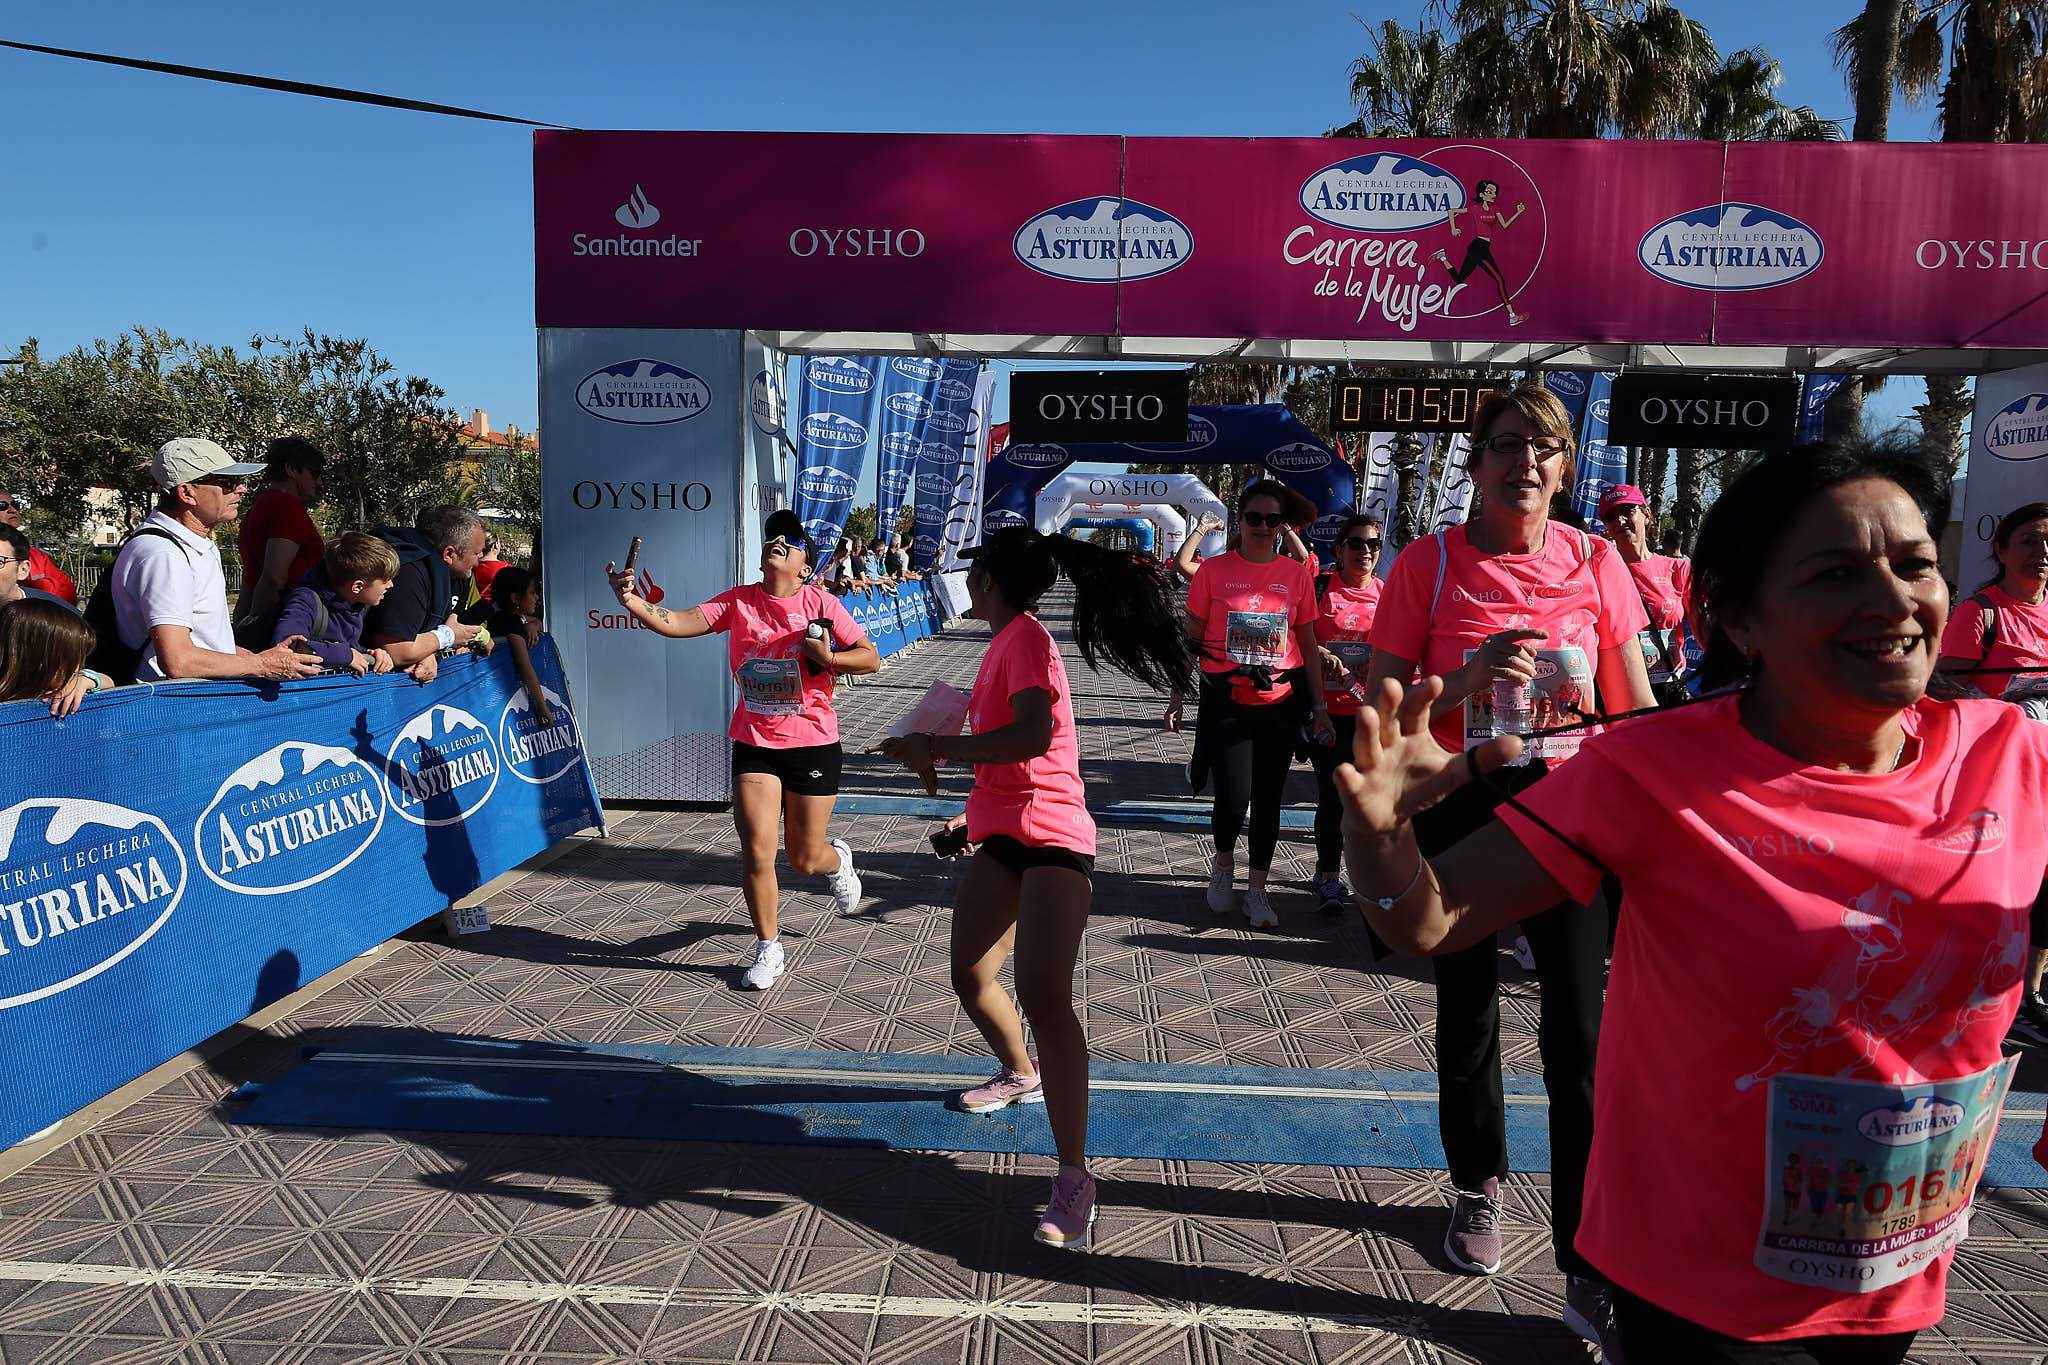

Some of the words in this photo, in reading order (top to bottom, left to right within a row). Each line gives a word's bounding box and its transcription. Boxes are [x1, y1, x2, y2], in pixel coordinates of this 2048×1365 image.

[1311, 180, 1452, 212] ASTURIANA
[1338, 179, 1391, 188] CENTRAL
[1395, 180, 1449, 189] LECHERA
[788, 228, 926, 258] OYSHO
[1055, 226, 1111, 235] CENTRAL
[1681, 233, 1739, 242] CENTRAL
[1744, 233, 1805, 242] LECHERA
[573, 233, 703, 257] Santander
[1027, 228, 1180, 260] ASTURIANA
[1282, 225, 1418, 270] Carrera
[1651, 234, 1809, 268] ASTURIANA
[1314, 268, 1339, 297] de
[1344, 268, 1363, 298] la
[1356, 264, 1468, 332] Mujer
[606, 381, 650, 389] CENTRAL
[653, 381, 697, 390] LECHERA
[808, 364, 869, 389] ASTURIANA
[586, 383, 702, 409] ASTURIANA
[1038, 394, 1164, 421] OYSHO
[1639, 397, 1770, 427] OYSHO
[804, 420, 862, 443] ASTURIANA
[1009, 450, 1063, 462] ASTURIANA
[1271, 454, 1328, 466] ASTURIANA
[572, 480, 712, 512] OYSHO
[798, 481, 853, 496] ASTURIANA
[1088, 479, 1169, 497] OYSHO
[1308, 525, 1341, 537] ASTUR
[1472, 729, 1492, 738] CARR
[1544, 743, 1580, 751] Santande
[400, 747, 495, 809] ASTURIANA
[240, 786, 304, 817] CENTRAL
[306, 770, 364, 796] LECHERA
[220, 788, 378, 875] ASTURIANA
[0, 862, 53, 890] TRAL
[63, 832, 153, 872] LECHERA
[1866, 1114, 1958, 1137] ASTURIANA
[1863, 1169, 1947, 1215] 016
[1881, 1214, 1917, 1236] 1789
[1778, 1235, 1848, 1254] CARRERA
[1850, 1242, 1870, 1255] DE
[1872, 1240, 1888, 1253] LA
[1890, 1228, 1926, 1250] MUJER
[1788, 1259, 1875, 1282] OYSHO
